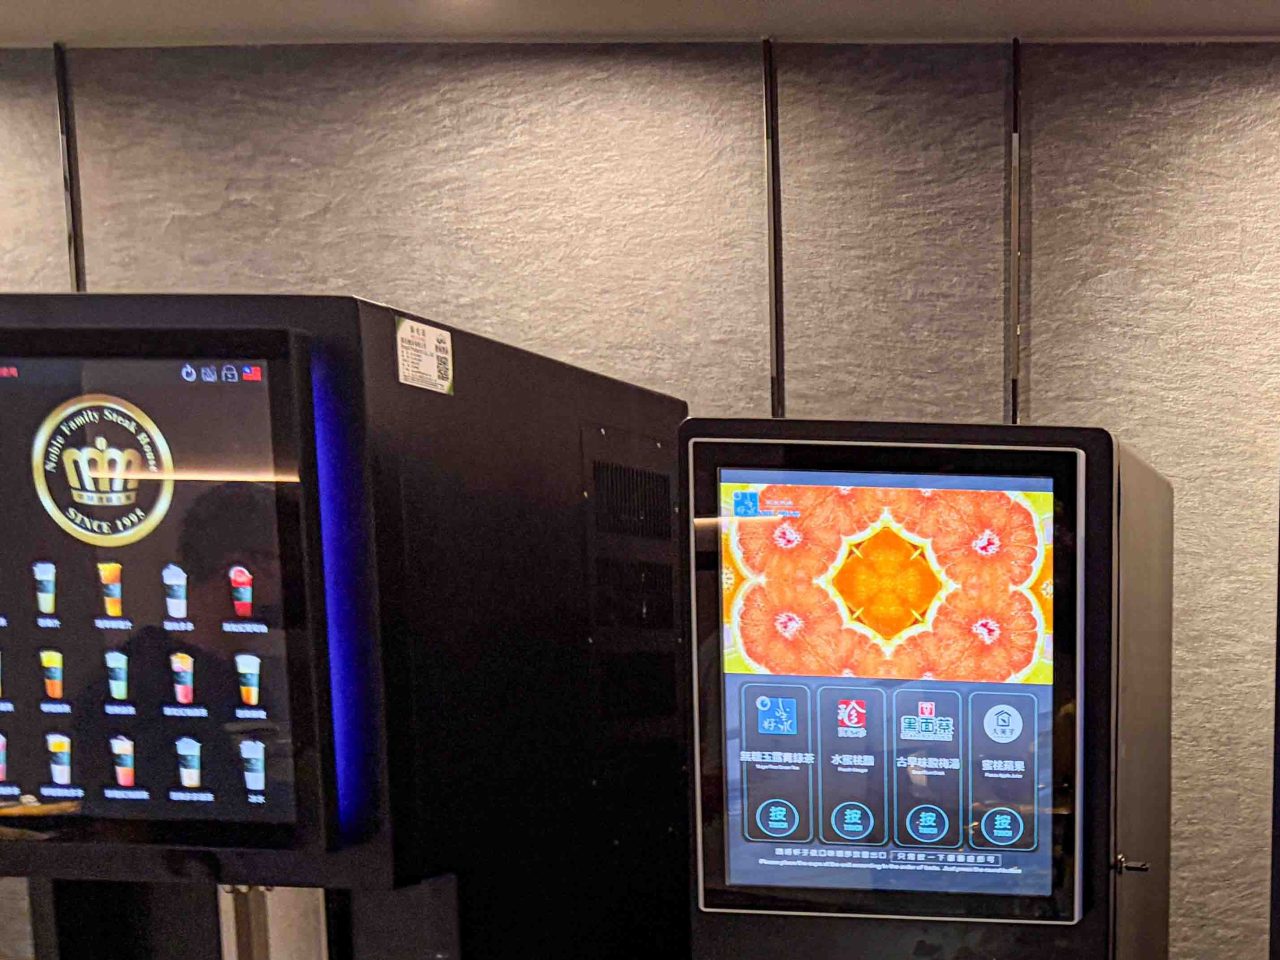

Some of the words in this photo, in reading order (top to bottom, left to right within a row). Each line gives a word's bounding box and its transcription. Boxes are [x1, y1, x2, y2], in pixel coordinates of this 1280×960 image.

[44, 437, 66, 473] Noble
[61, 408, 101, 437] Family
[103, 408, 138, 435] Steak
[136, 432, 159, 473] House
[64, 507, 112, 534] SINCE
[769, 806, 787, 821] 按
[844, 809, 862, 823] 按
[919, 812, 937, 826] 按
[994, 815, 1011, 829] 按
